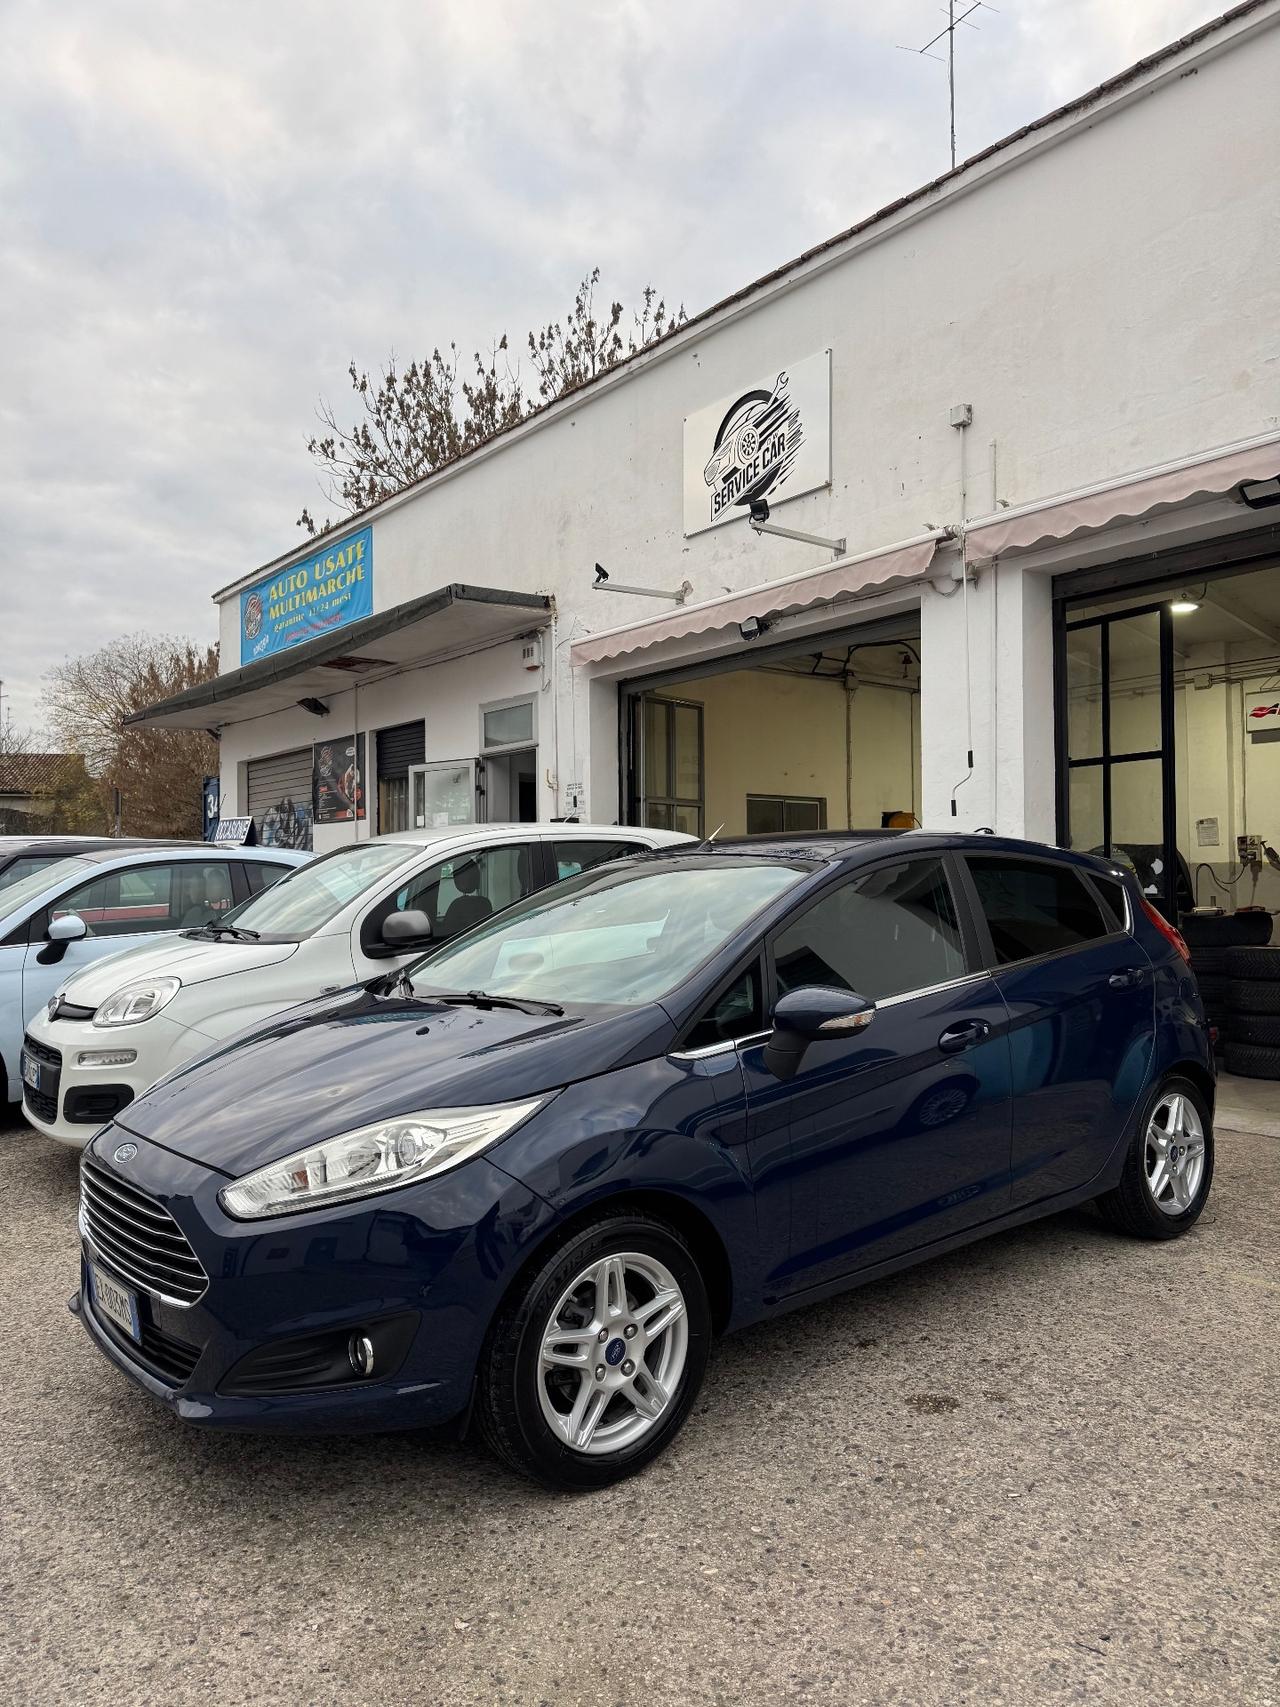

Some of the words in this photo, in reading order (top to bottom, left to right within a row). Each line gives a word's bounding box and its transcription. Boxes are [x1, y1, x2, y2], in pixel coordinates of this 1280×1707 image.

[714, 456, 760, 515] SERVICE
[762, 432, 786, 470] CAR
[269, 569, 308, 603] AUTO
[314, 539, 366, 580] USATE
[269, 563, 366, 621] MULTIMARCHE
